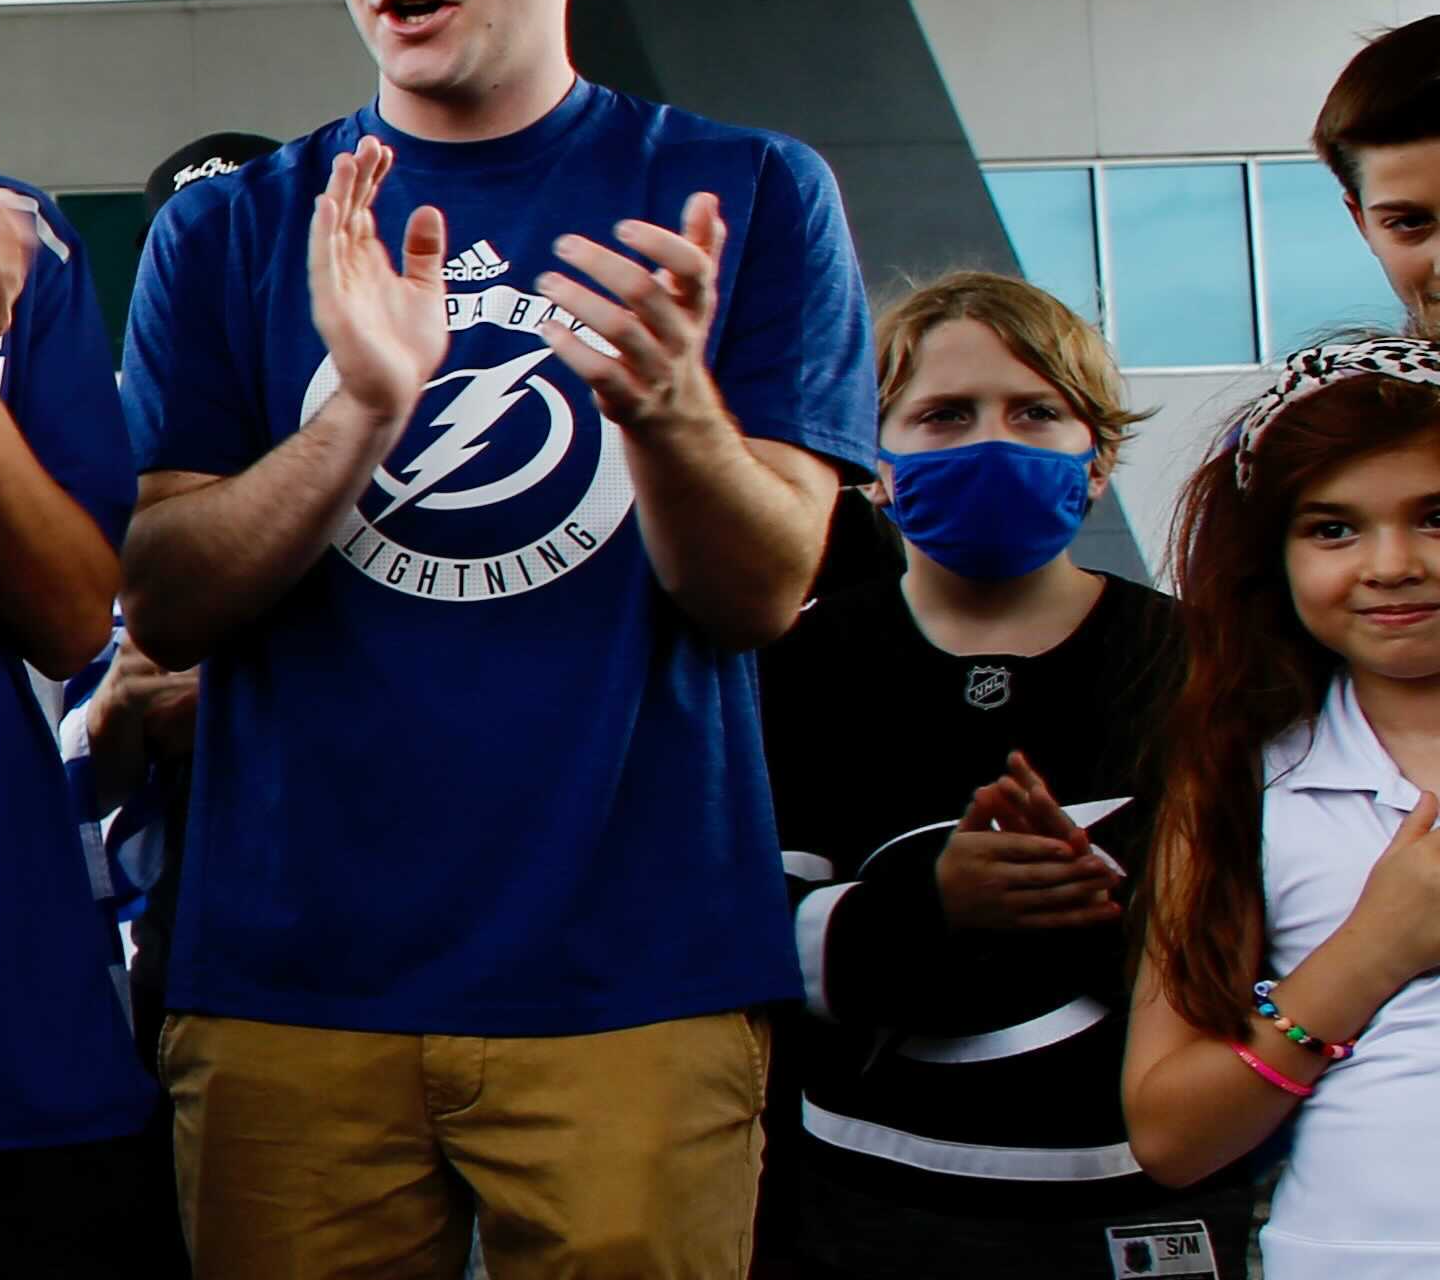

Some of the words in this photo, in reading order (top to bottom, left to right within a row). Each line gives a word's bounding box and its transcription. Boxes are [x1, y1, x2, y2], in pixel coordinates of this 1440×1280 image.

[441, 261, 511, 282] adidas
[342, 521, 597, 598] LIGHTNING
[1166, 1235, 1200, 1255] S/M
